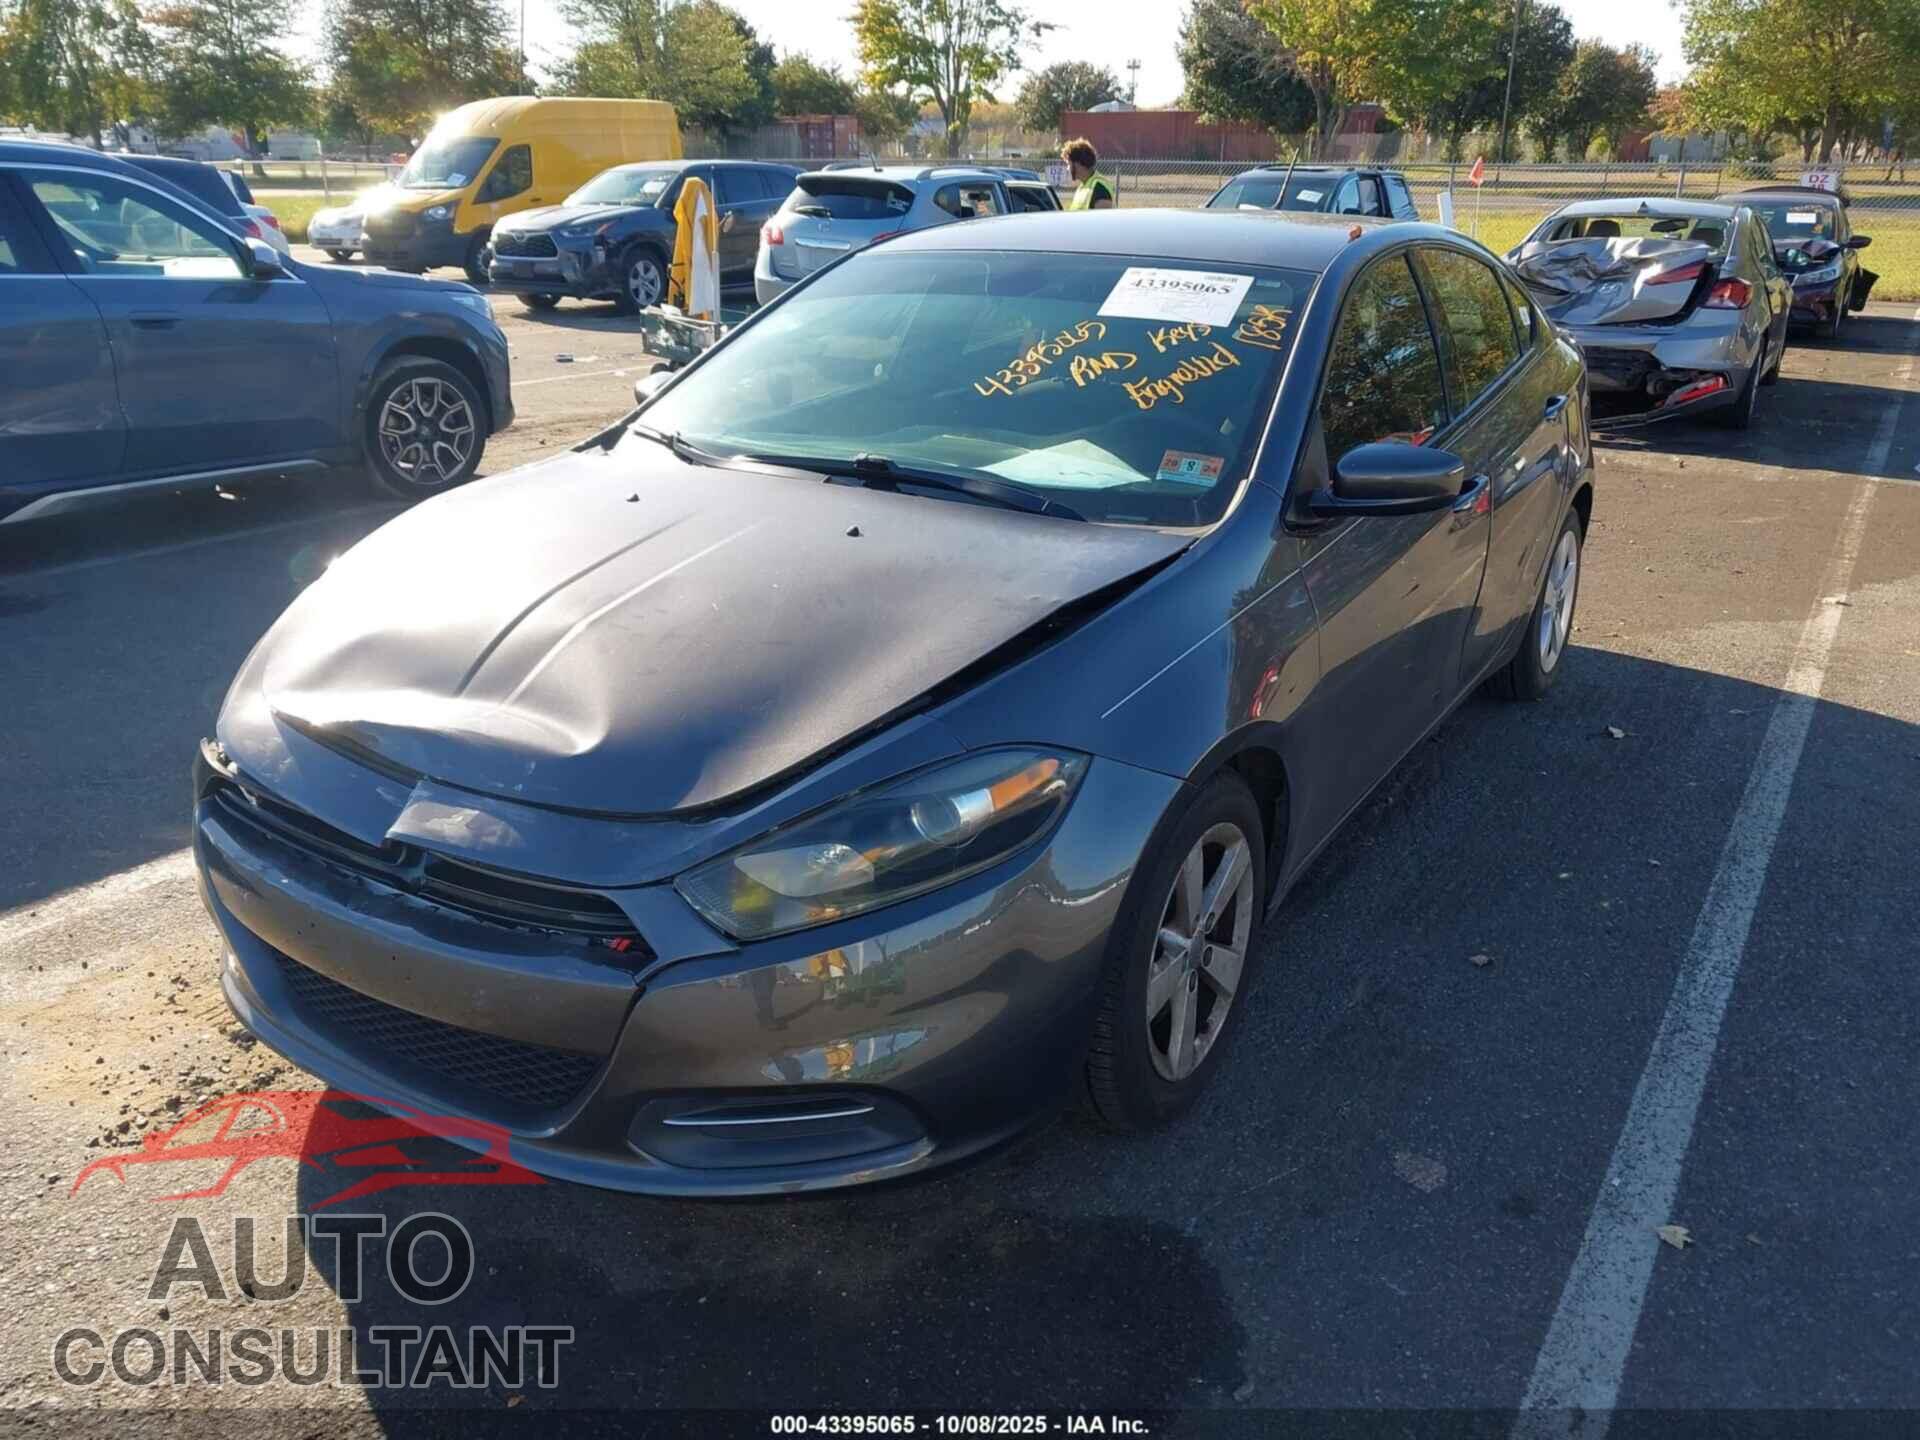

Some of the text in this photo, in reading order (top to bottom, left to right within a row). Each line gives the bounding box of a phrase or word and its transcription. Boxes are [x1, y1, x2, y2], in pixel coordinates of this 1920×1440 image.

[1809, 174, 1829, 183] DZ
[1130, 277, 1233, 296] 43395065
[1146, 319, 1212, 353] Keys
